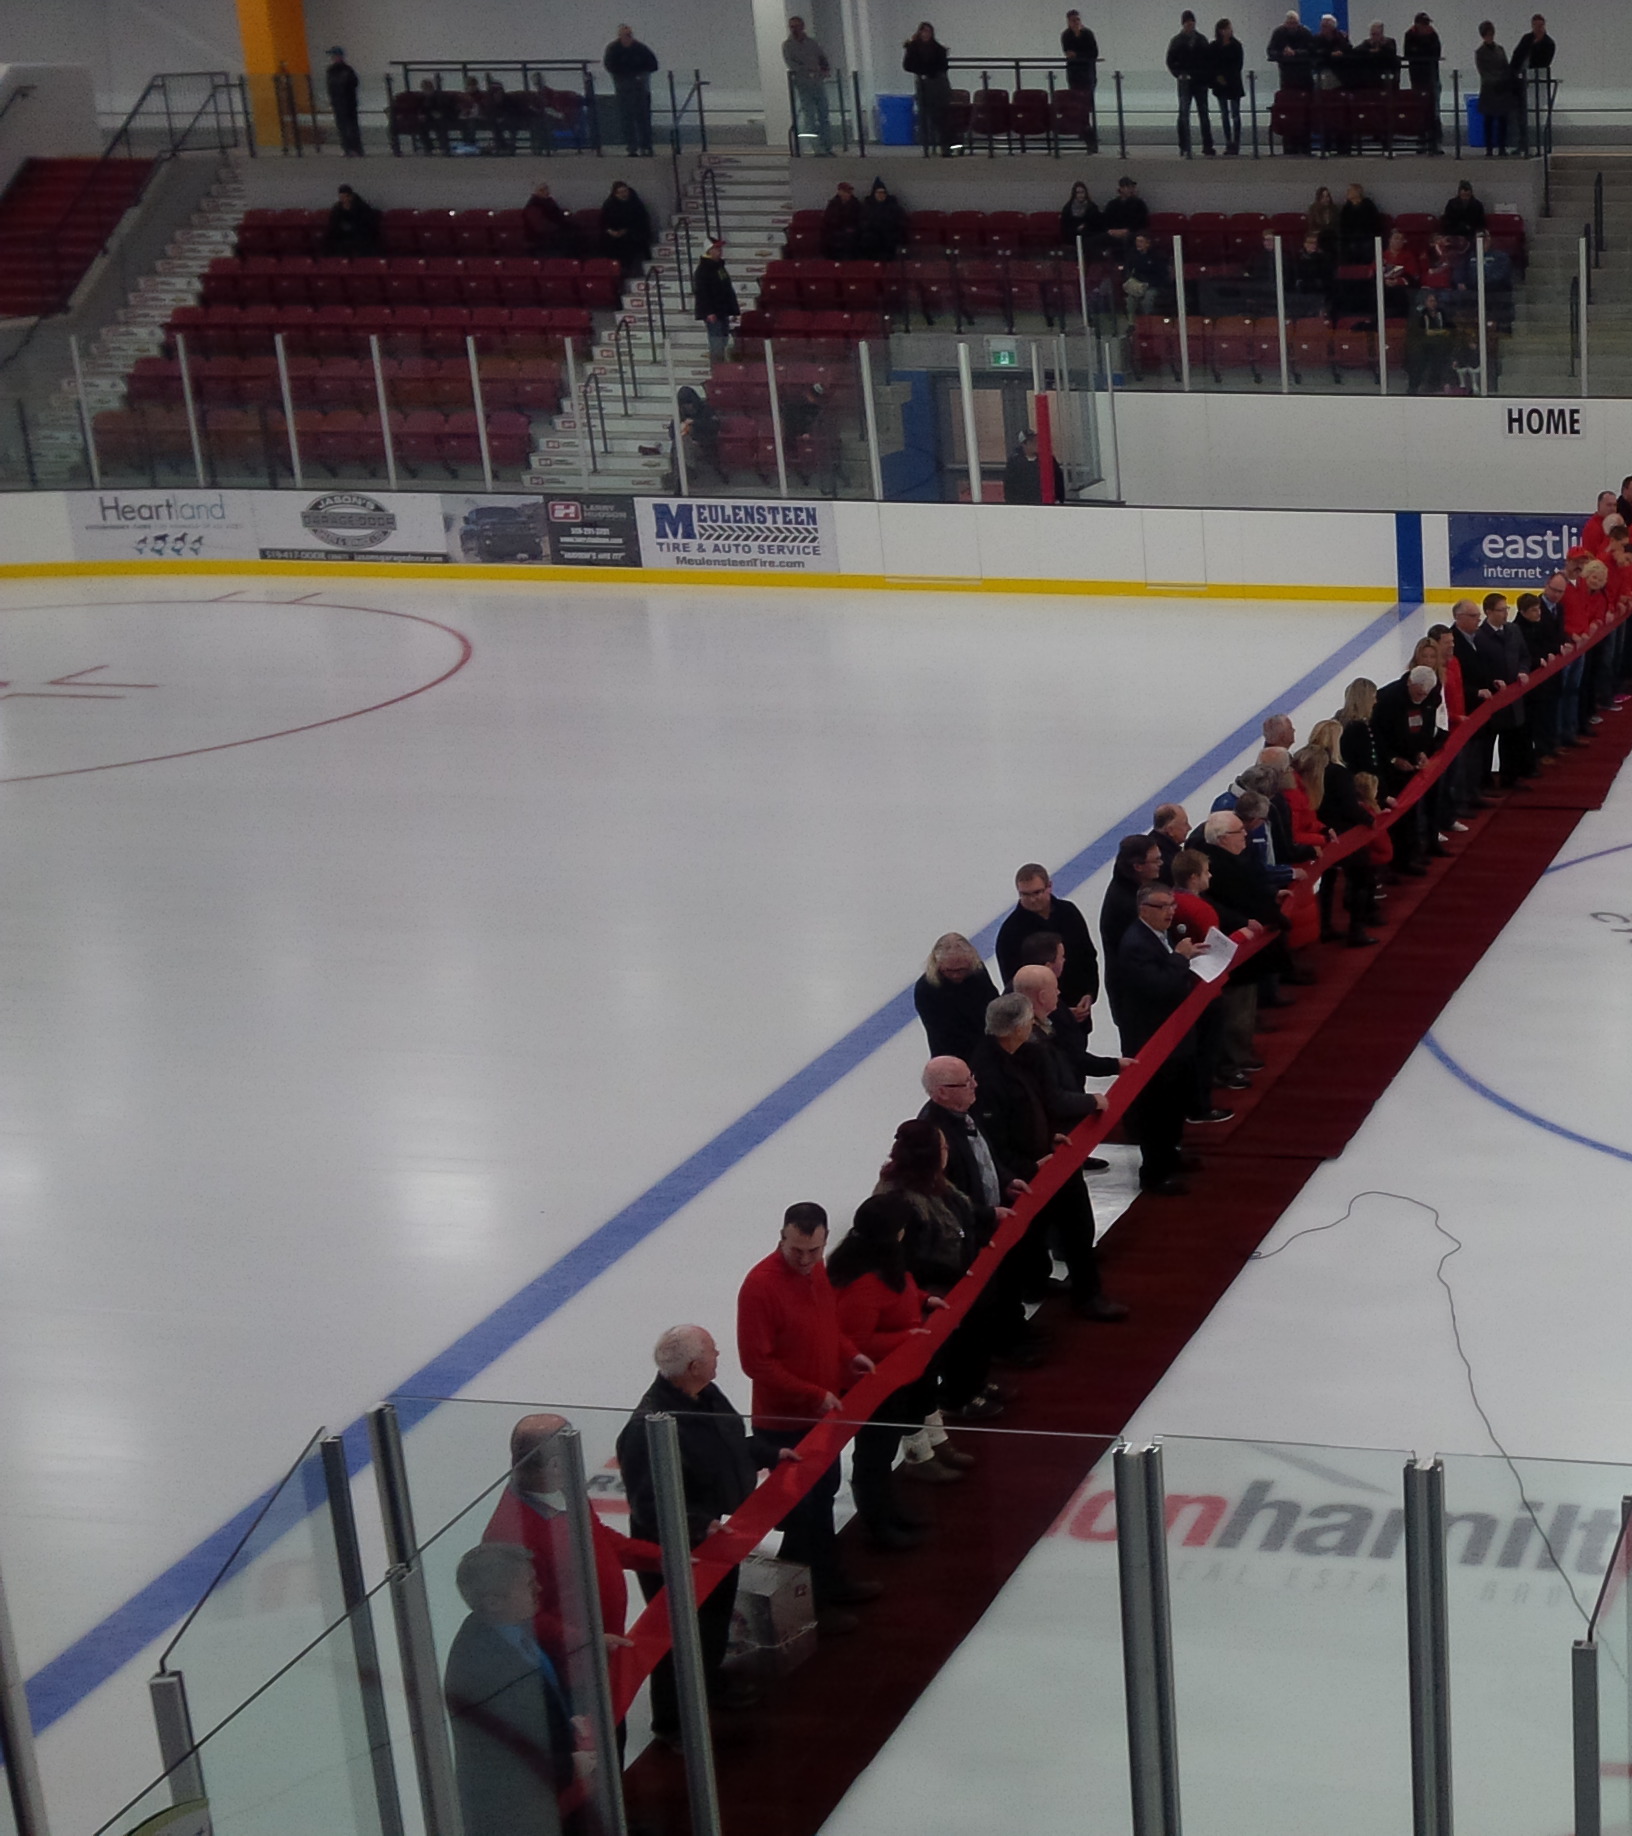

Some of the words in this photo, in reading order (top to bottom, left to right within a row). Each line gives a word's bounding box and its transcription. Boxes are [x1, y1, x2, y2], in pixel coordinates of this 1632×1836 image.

[1507, 408, 1580, 434] HOME
[99, 494, 225, 521] Heartland
[652, 503, 818, 539] MEULENSTEEN
[656, 542, 691, 553] TIRE
[693, 543, 706, 553] &
[711, 543, 753, 554] AUTO
[757, 544, 822, 556] SERVICE
[1482, 525, 1583, 559] eastli
[676, 555, 805, 569] MeulensteenTire.com
[1484, 564, 1542, 578] internet
